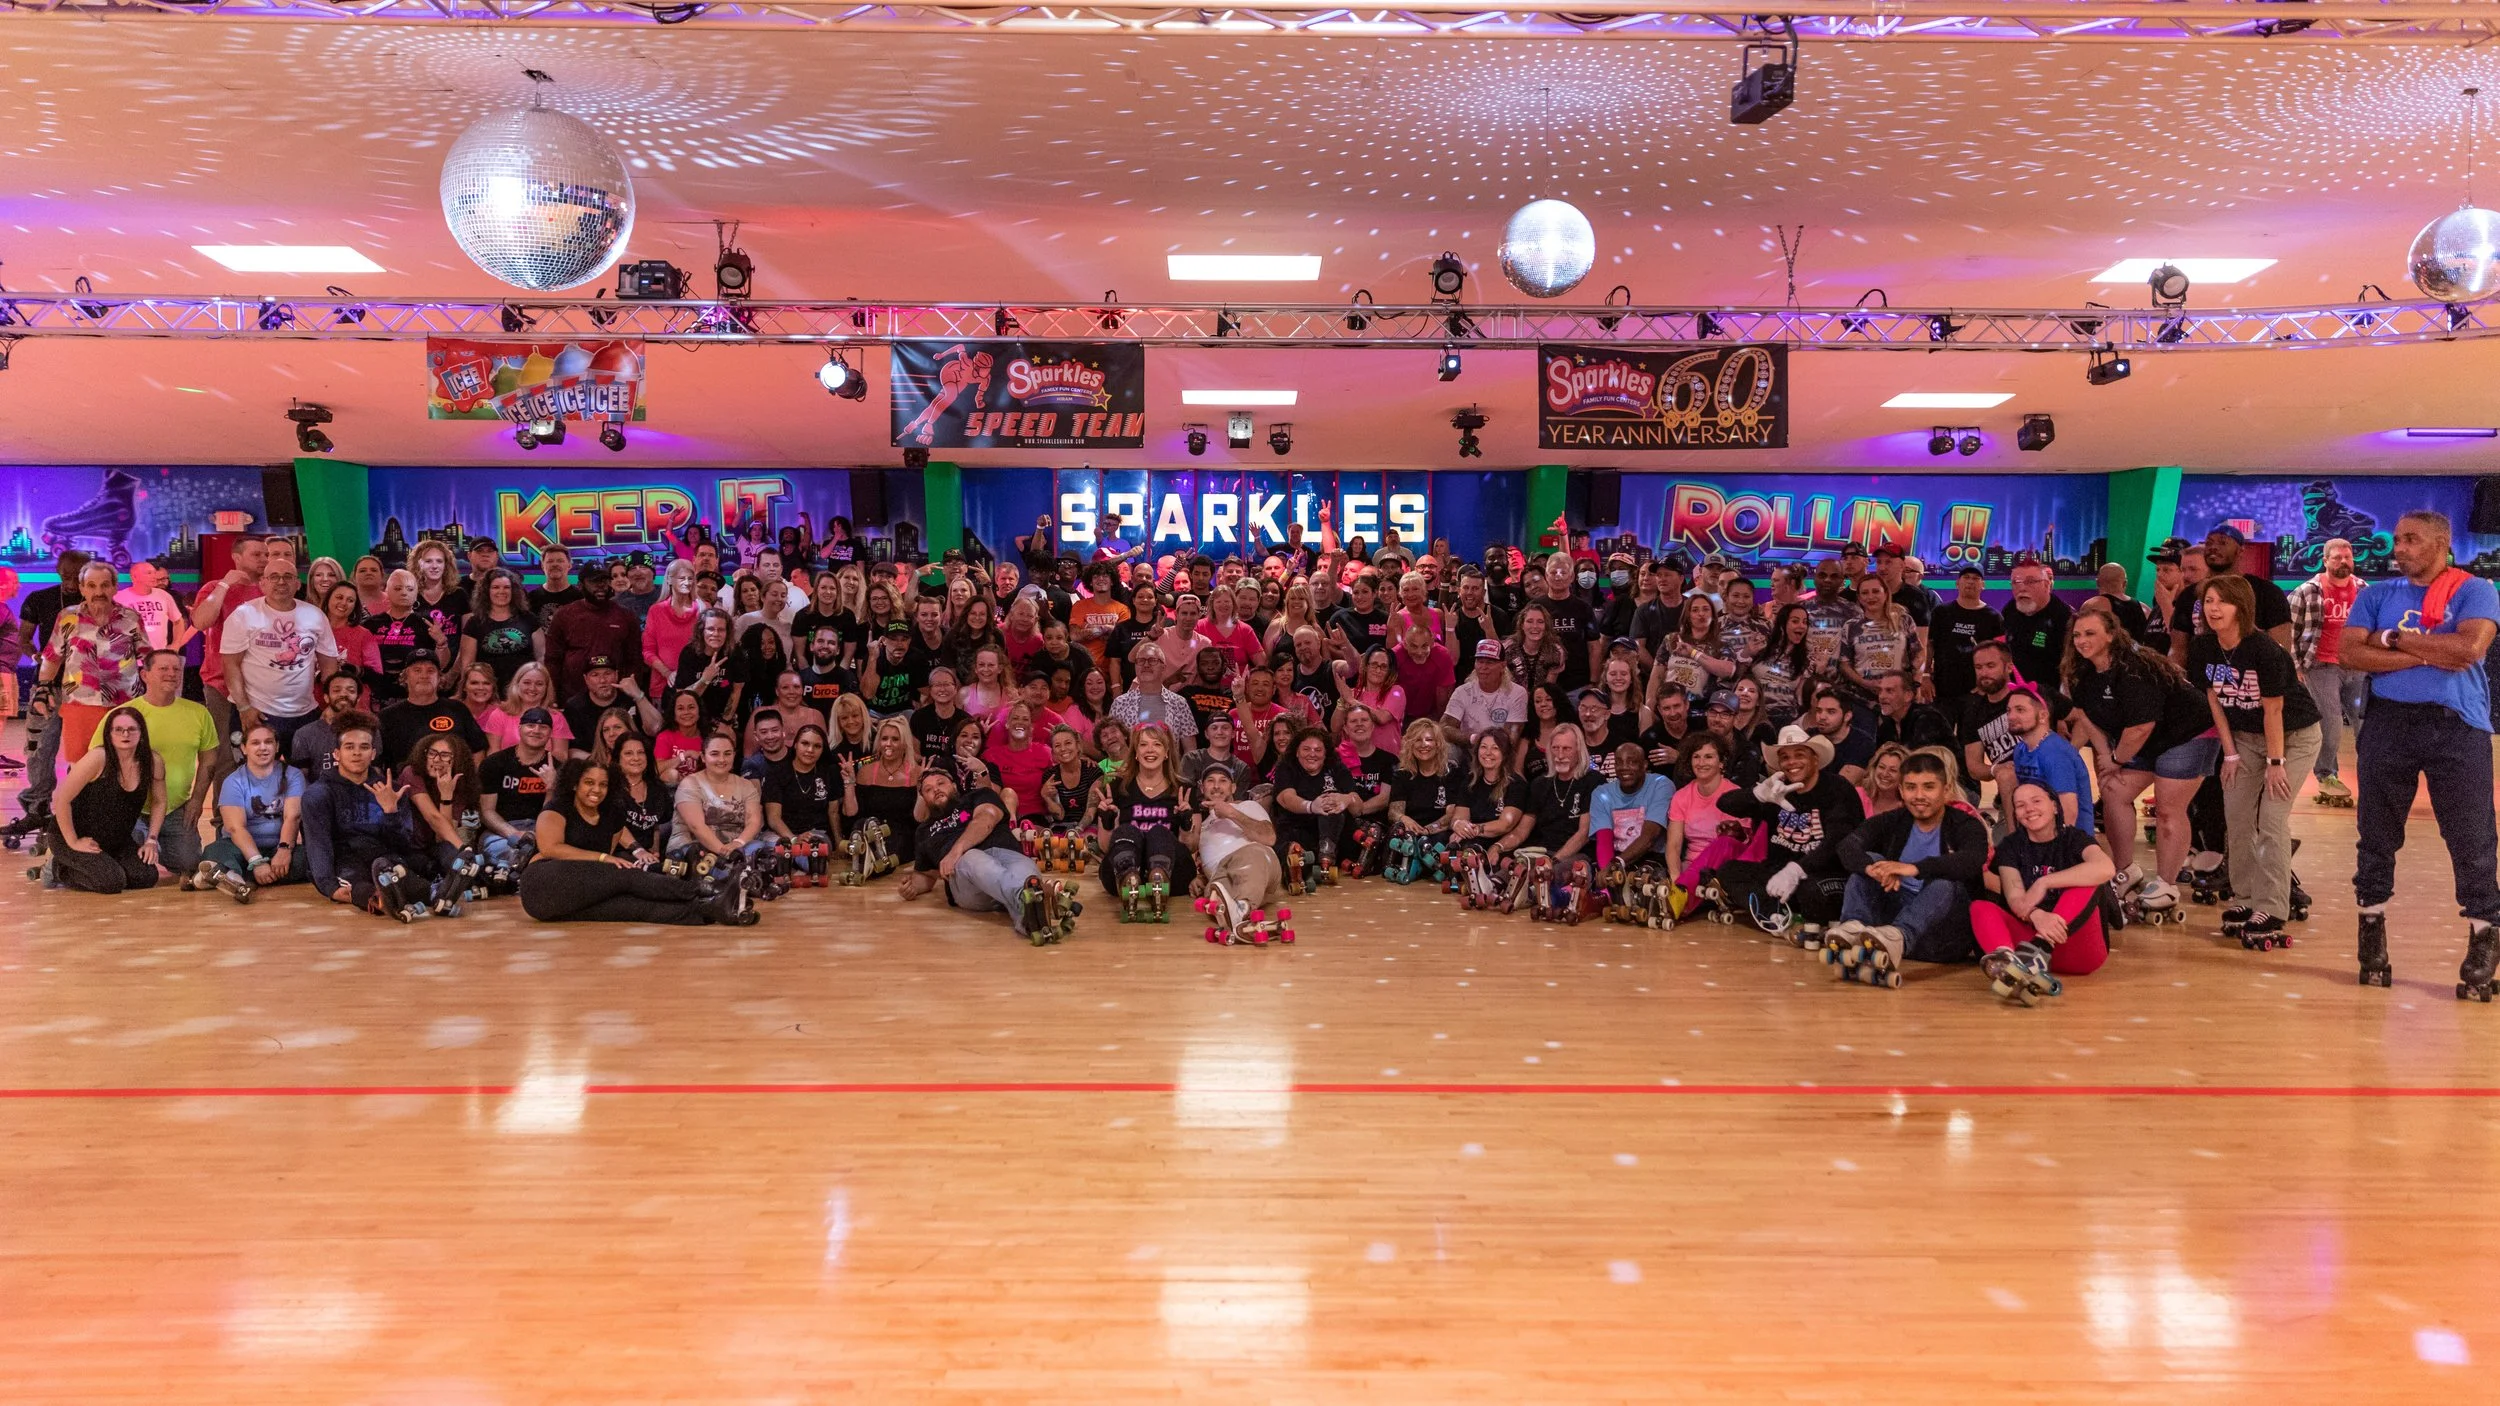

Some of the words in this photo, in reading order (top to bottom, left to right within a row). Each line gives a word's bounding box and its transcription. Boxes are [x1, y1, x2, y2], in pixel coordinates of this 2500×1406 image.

[449, 367, 483, 396] ICEE
[1010, 360, 1102, 395] Sparkles
[1070, 386, 1093, 395] CENTERS
[1549, 359, 1652, 405] Sparkles
[1656, 347, 1775, 427] 60
[588, 385, 630, 413] ICEE
[1582, 396, 1602, 405] FAMILY
[1602, 395, 1615, 403] FUN
[1615, 396, 1641, 408] CENTERS
[964, 411, 1058, 437] SPEED
[1070, 411, 1144, 438] TEAM
[1547, 423, 1606, 444] YEAR
[1611, 423, 1775, 445] ANNIVERSARY
[221, 511, 239, 526] EXIT
[499, 487, 696, 557] KEEP
[717, 478, 788, 546] IT
[1060, 492, 1426, 543] SPARKLES
[1668, 483, 1920, 560] ROLLIN
[1944, 504, 1994, 563] !!
[2233, 519, 2250, 533] EXIT
[2323, 597, 2351, 618] Cok
[1952, 628, 1976, 636] ADDICT
[1954, 622, 1976, 630] SKATE
[813, 686, 838, 696] bros
[2205, 663, 2260, 700] USA
[1986, 732, 2023, 761] RACIN
[502, 775, 520, 789] DP
[520, 779, 546, 791] bros
[1133, 803, 1168, 818] Born
[1776, 808, 1824, 843] USA
